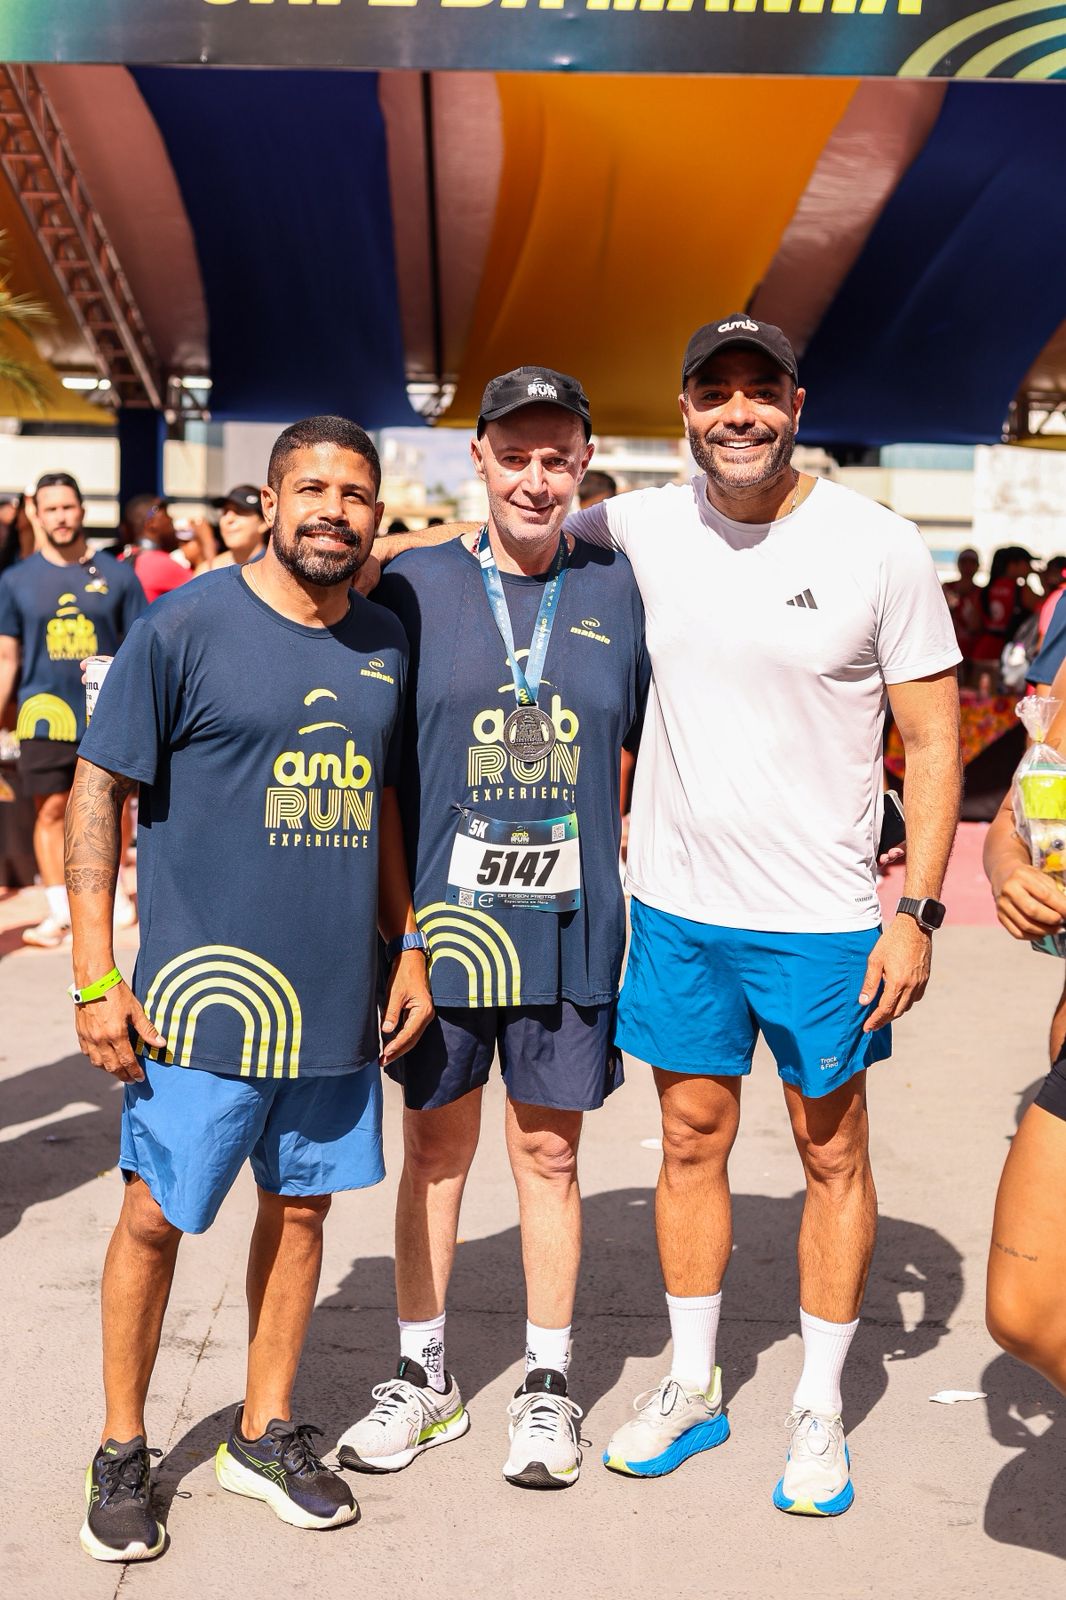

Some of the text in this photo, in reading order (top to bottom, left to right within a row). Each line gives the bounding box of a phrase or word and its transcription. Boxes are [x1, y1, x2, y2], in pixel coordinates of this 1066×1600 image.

[718, 319, 759, 333] amb
[47, 613, 95, 637] amb
[570, 626, 611, 645] mahalo
[46, 634, 98, 653] RUN
[360, 669, 394, 685] mahalo
[273, 740, 373, 789] amb
[467, 743, 581, 787] RUN
[264, 786, 374, 832] RUN
[468, 819, 489, 839] 5K
[476, 849, 560, 887] 5147
